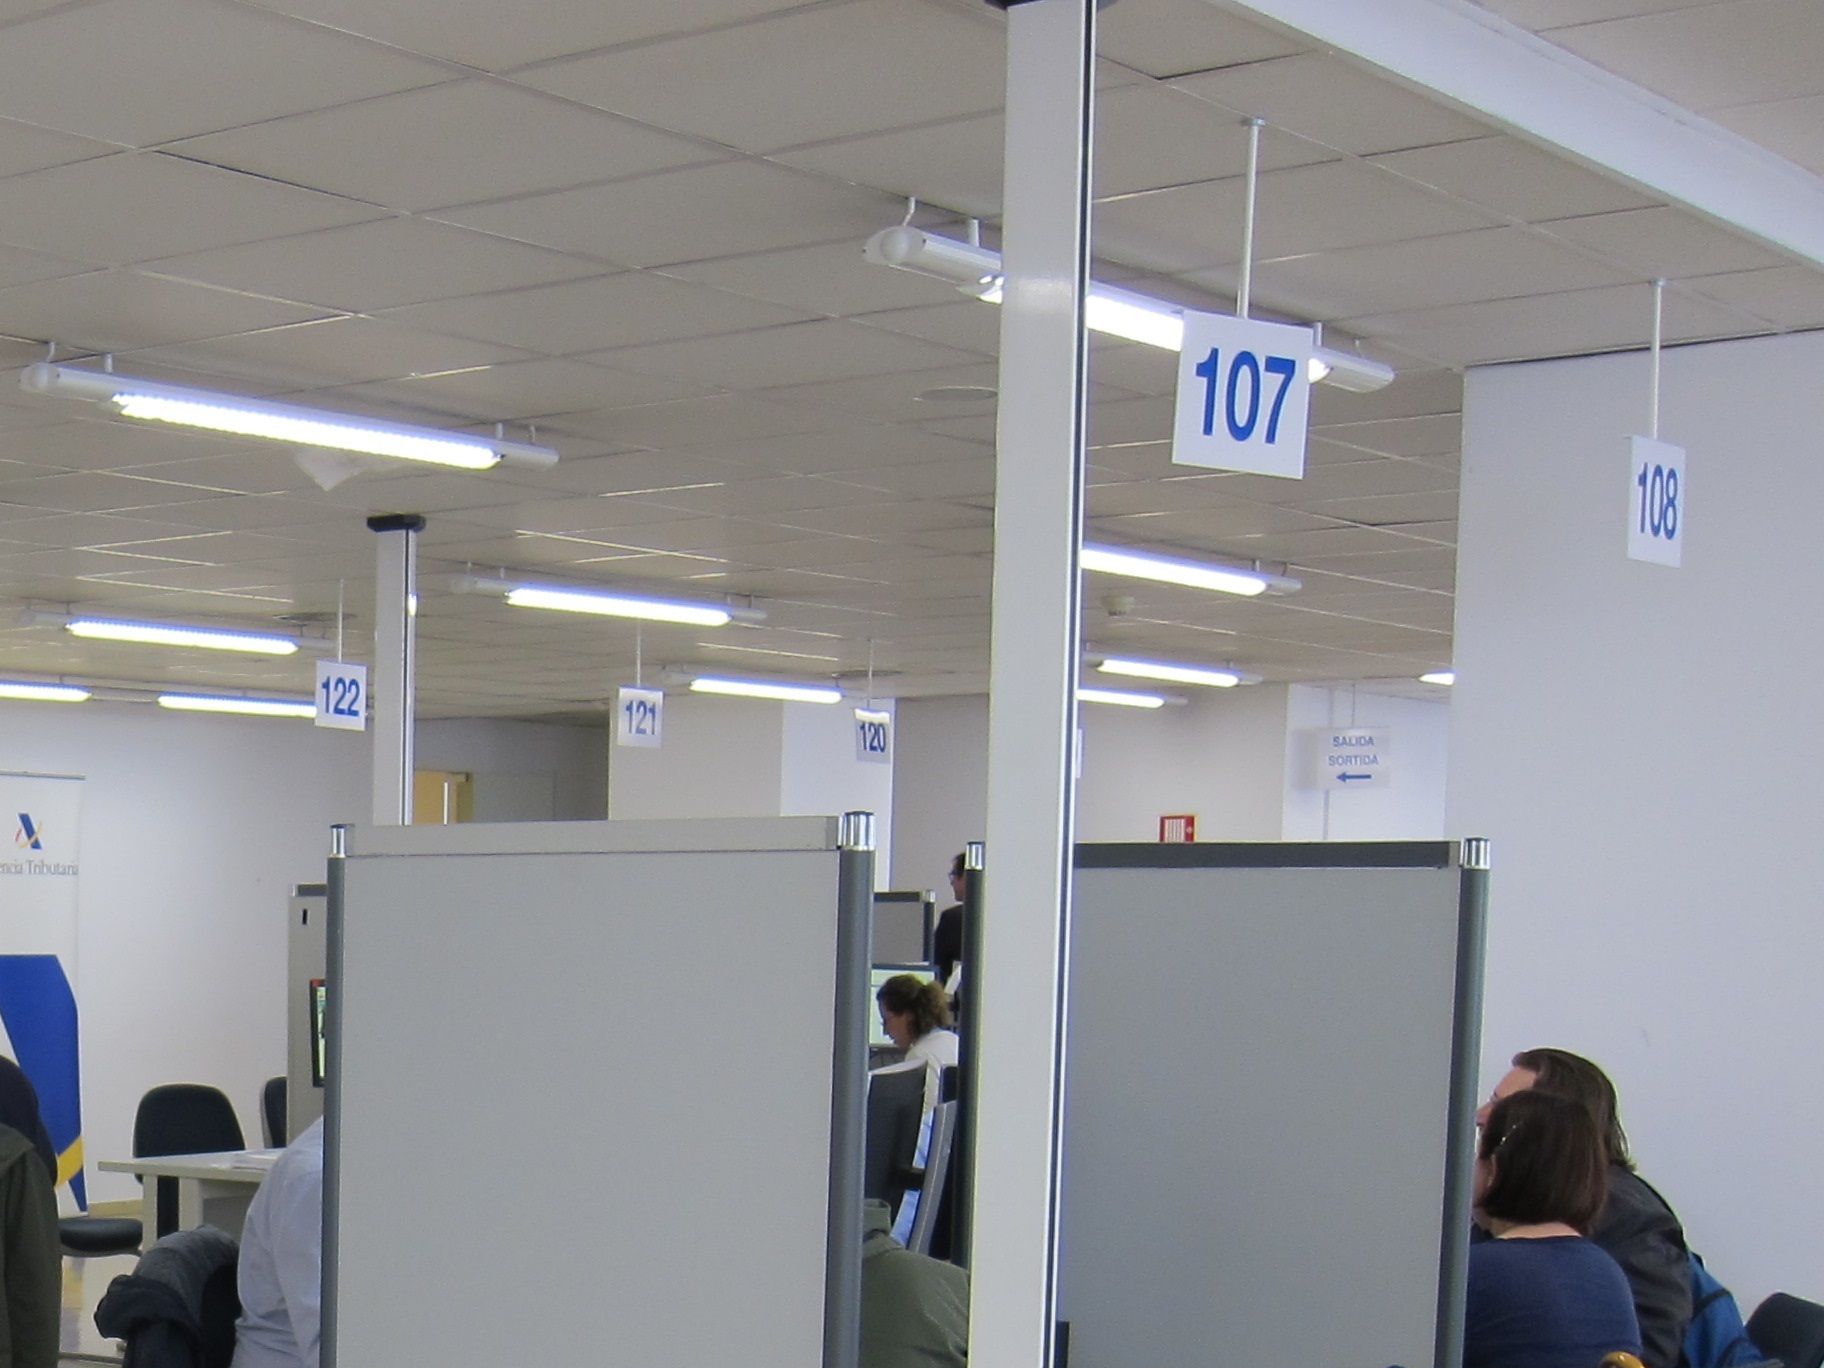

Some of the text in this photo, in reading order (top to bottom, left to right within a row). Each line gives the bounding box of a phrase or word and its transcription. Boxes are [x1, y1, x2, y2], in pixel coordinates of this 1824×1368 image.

[1196, 347, 1296, 444] 107
[1638, 462, 1678, 540] 108
[321, 676, 360, 717] 122
[626, 700, 656, 735] 121
[860, 721, 886, 753] 120
[1333, 735, 1375, 747] SALIDA
[1328, 754, 1378, 766] SORTIDA
